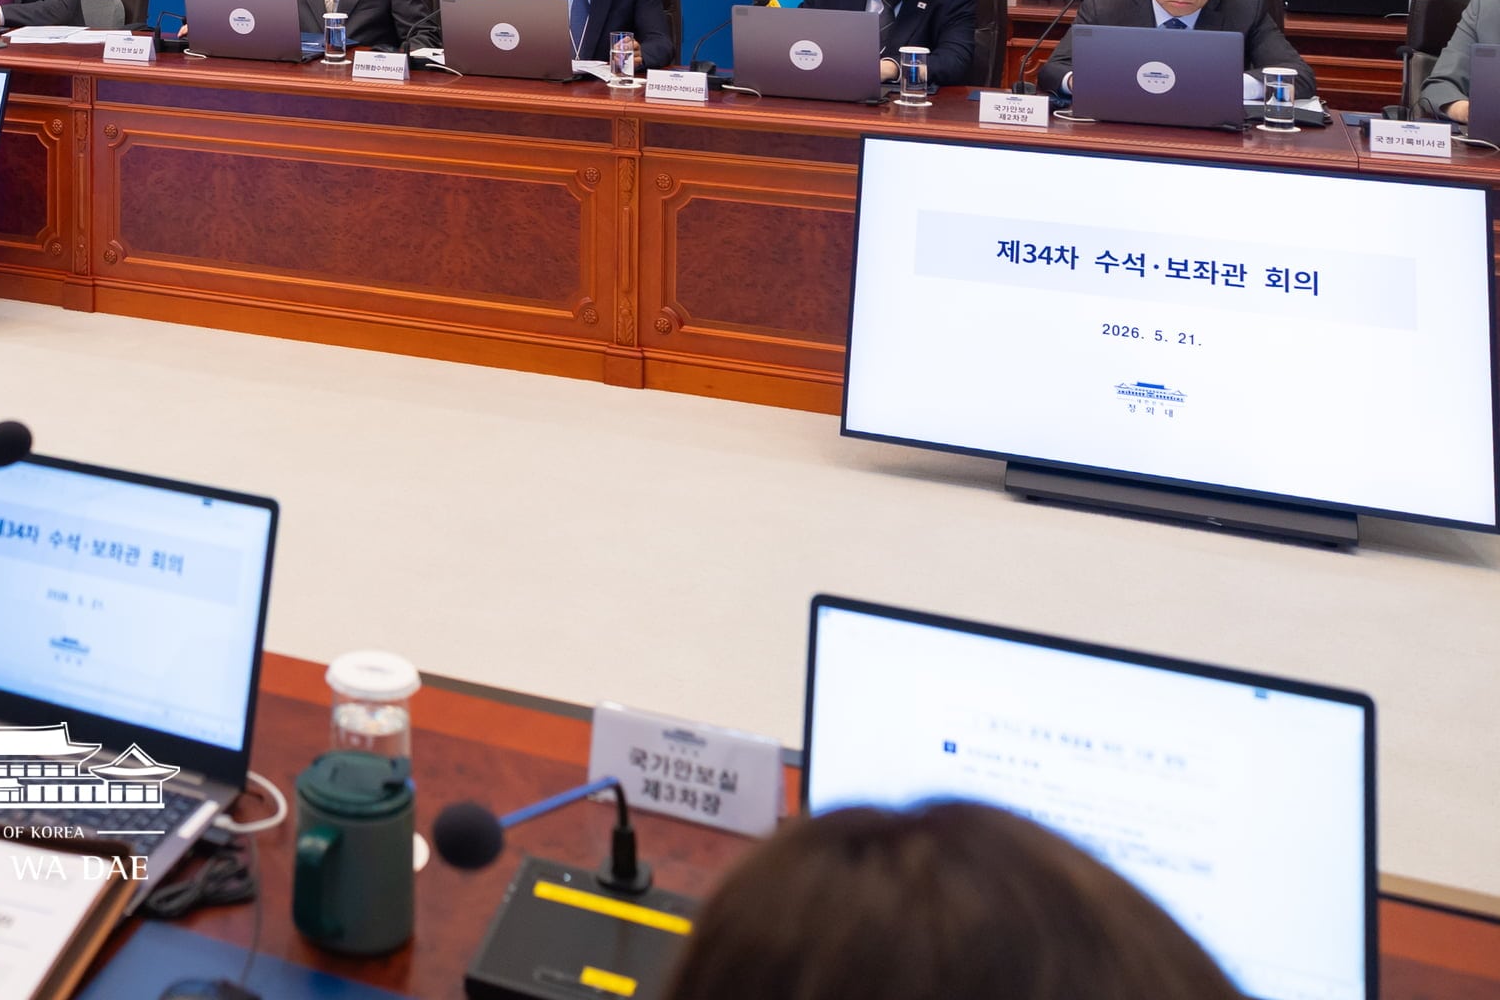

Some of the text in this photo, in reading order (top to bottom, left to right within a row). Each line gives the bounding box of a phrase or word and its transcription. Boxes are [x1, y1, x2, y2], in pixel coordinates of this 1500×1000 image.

[993, 104, 1035, 115] 국가안보실
[998, 113, 1029, 123] 제2차장
[1374, 135, 1446, 149] 국정기록비서관
[996, 238, 1320, 297] 제34차 수석·보좌관 회의
[1101, 323, 1203, 347] 2026. 5. 21.
[149, 549, 186, 577] 회의
[630, 747, 738, 793] 국가안보실
[643, 778, 721, 817] 제3차장
